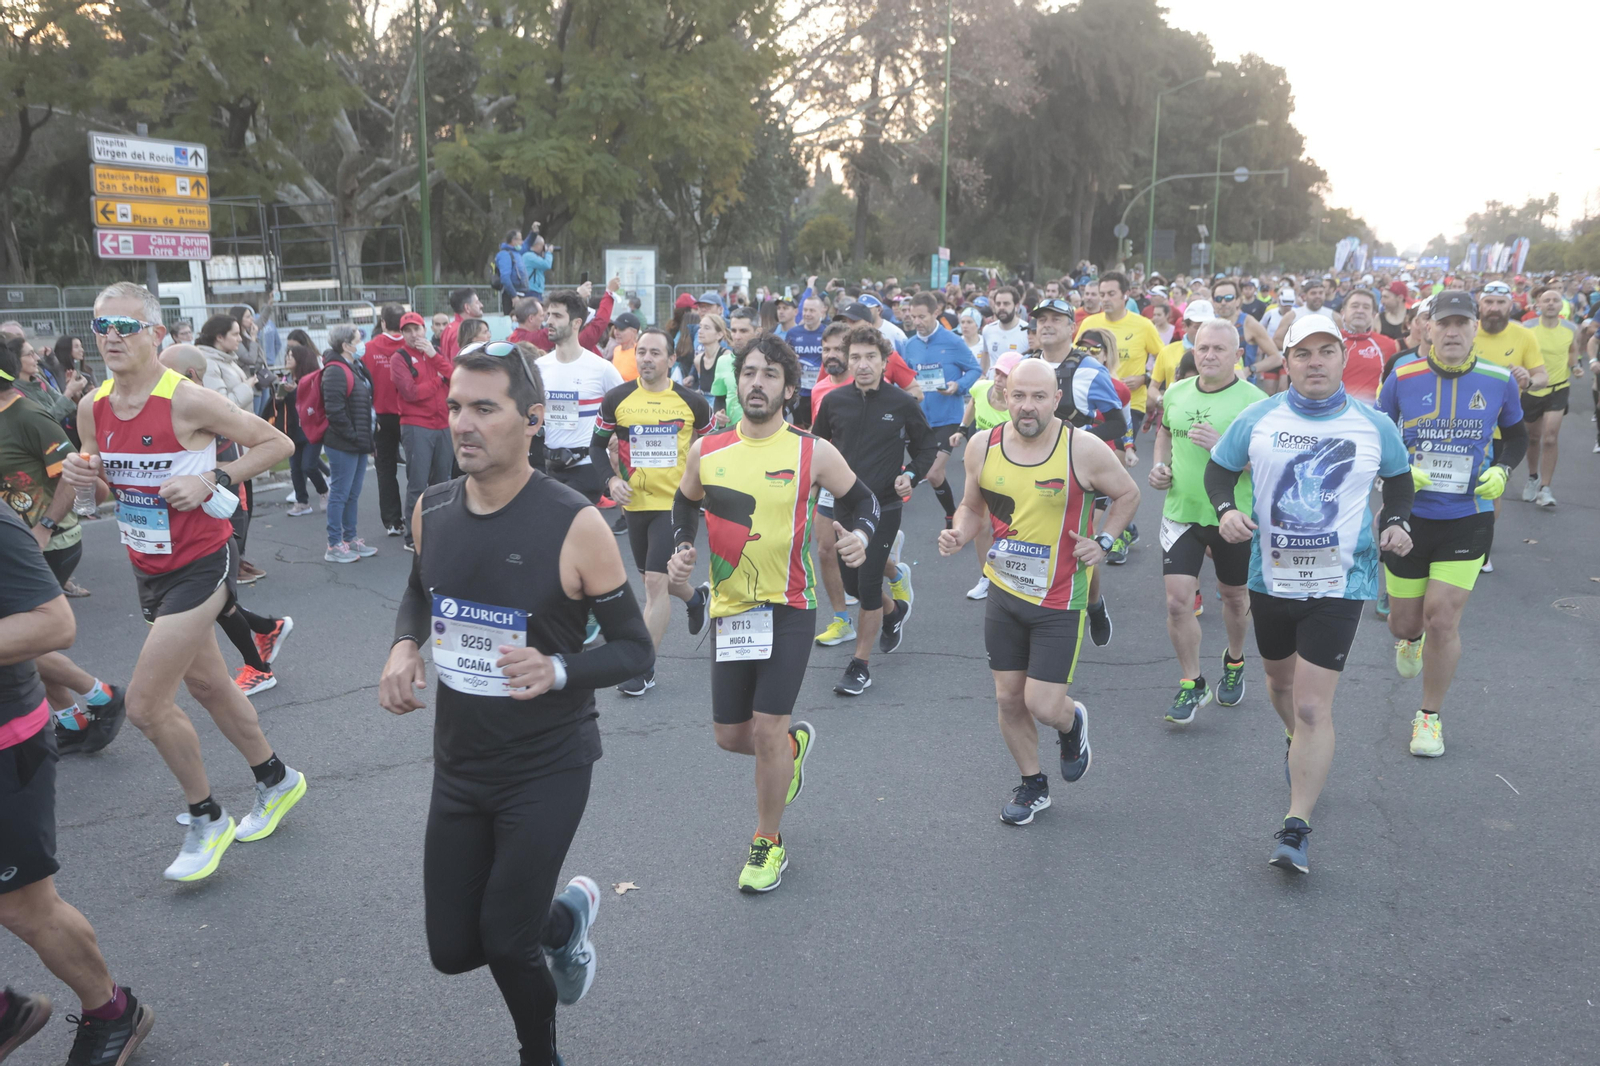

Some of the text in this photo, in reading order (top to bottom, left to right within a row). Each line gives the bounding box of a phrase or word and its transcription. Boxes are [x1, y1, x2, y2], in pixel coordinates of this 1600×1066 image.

[96, 146, 127, 160] Virgen
[131, 151, 146, 161] del
[134, 173, 160, 184] Prado
[99, 182, 117, 192] San
[133, 214, 207, 227] Plaza de Armas
[149, 235, 208, 246] Caixa Forum
[148, 245, 208, 257] Torre Sevilla
[1417, 418, 1433, 428] C.D.
[644, 426, 672, 434] ZURICH
[1416, 428, 1483, 440] MIRAFLORES
[1278, 431, 1318, 445] Cross
[1278, 440, 1317, 450] Nocturno
[1433, 444, 1468, 453] ZURICH
[1432, 459, 1453, 468] 9175
[1430, 472, 1452, 480] WANIN
[1320, 492, 1338, 502] 15K
[124, 513, 148, 526] 10489
[130, 528, 146, 538] JULIO
[1290, 536, 1330, 546] ZURICH
[1008, 542, 1042, 555] ZURICH
[1006, 560, 1026, 572] 9723
[1292, 556, 1316, 566] 9777
[460, 606, 514, 626] ZURICH
[732, 620, 751, 630] 8713
[461, 634, 492, 652] 9259
[730, 636, 754, 645] HUGO A.
[457, 656, 492, 673] OCAÑA
